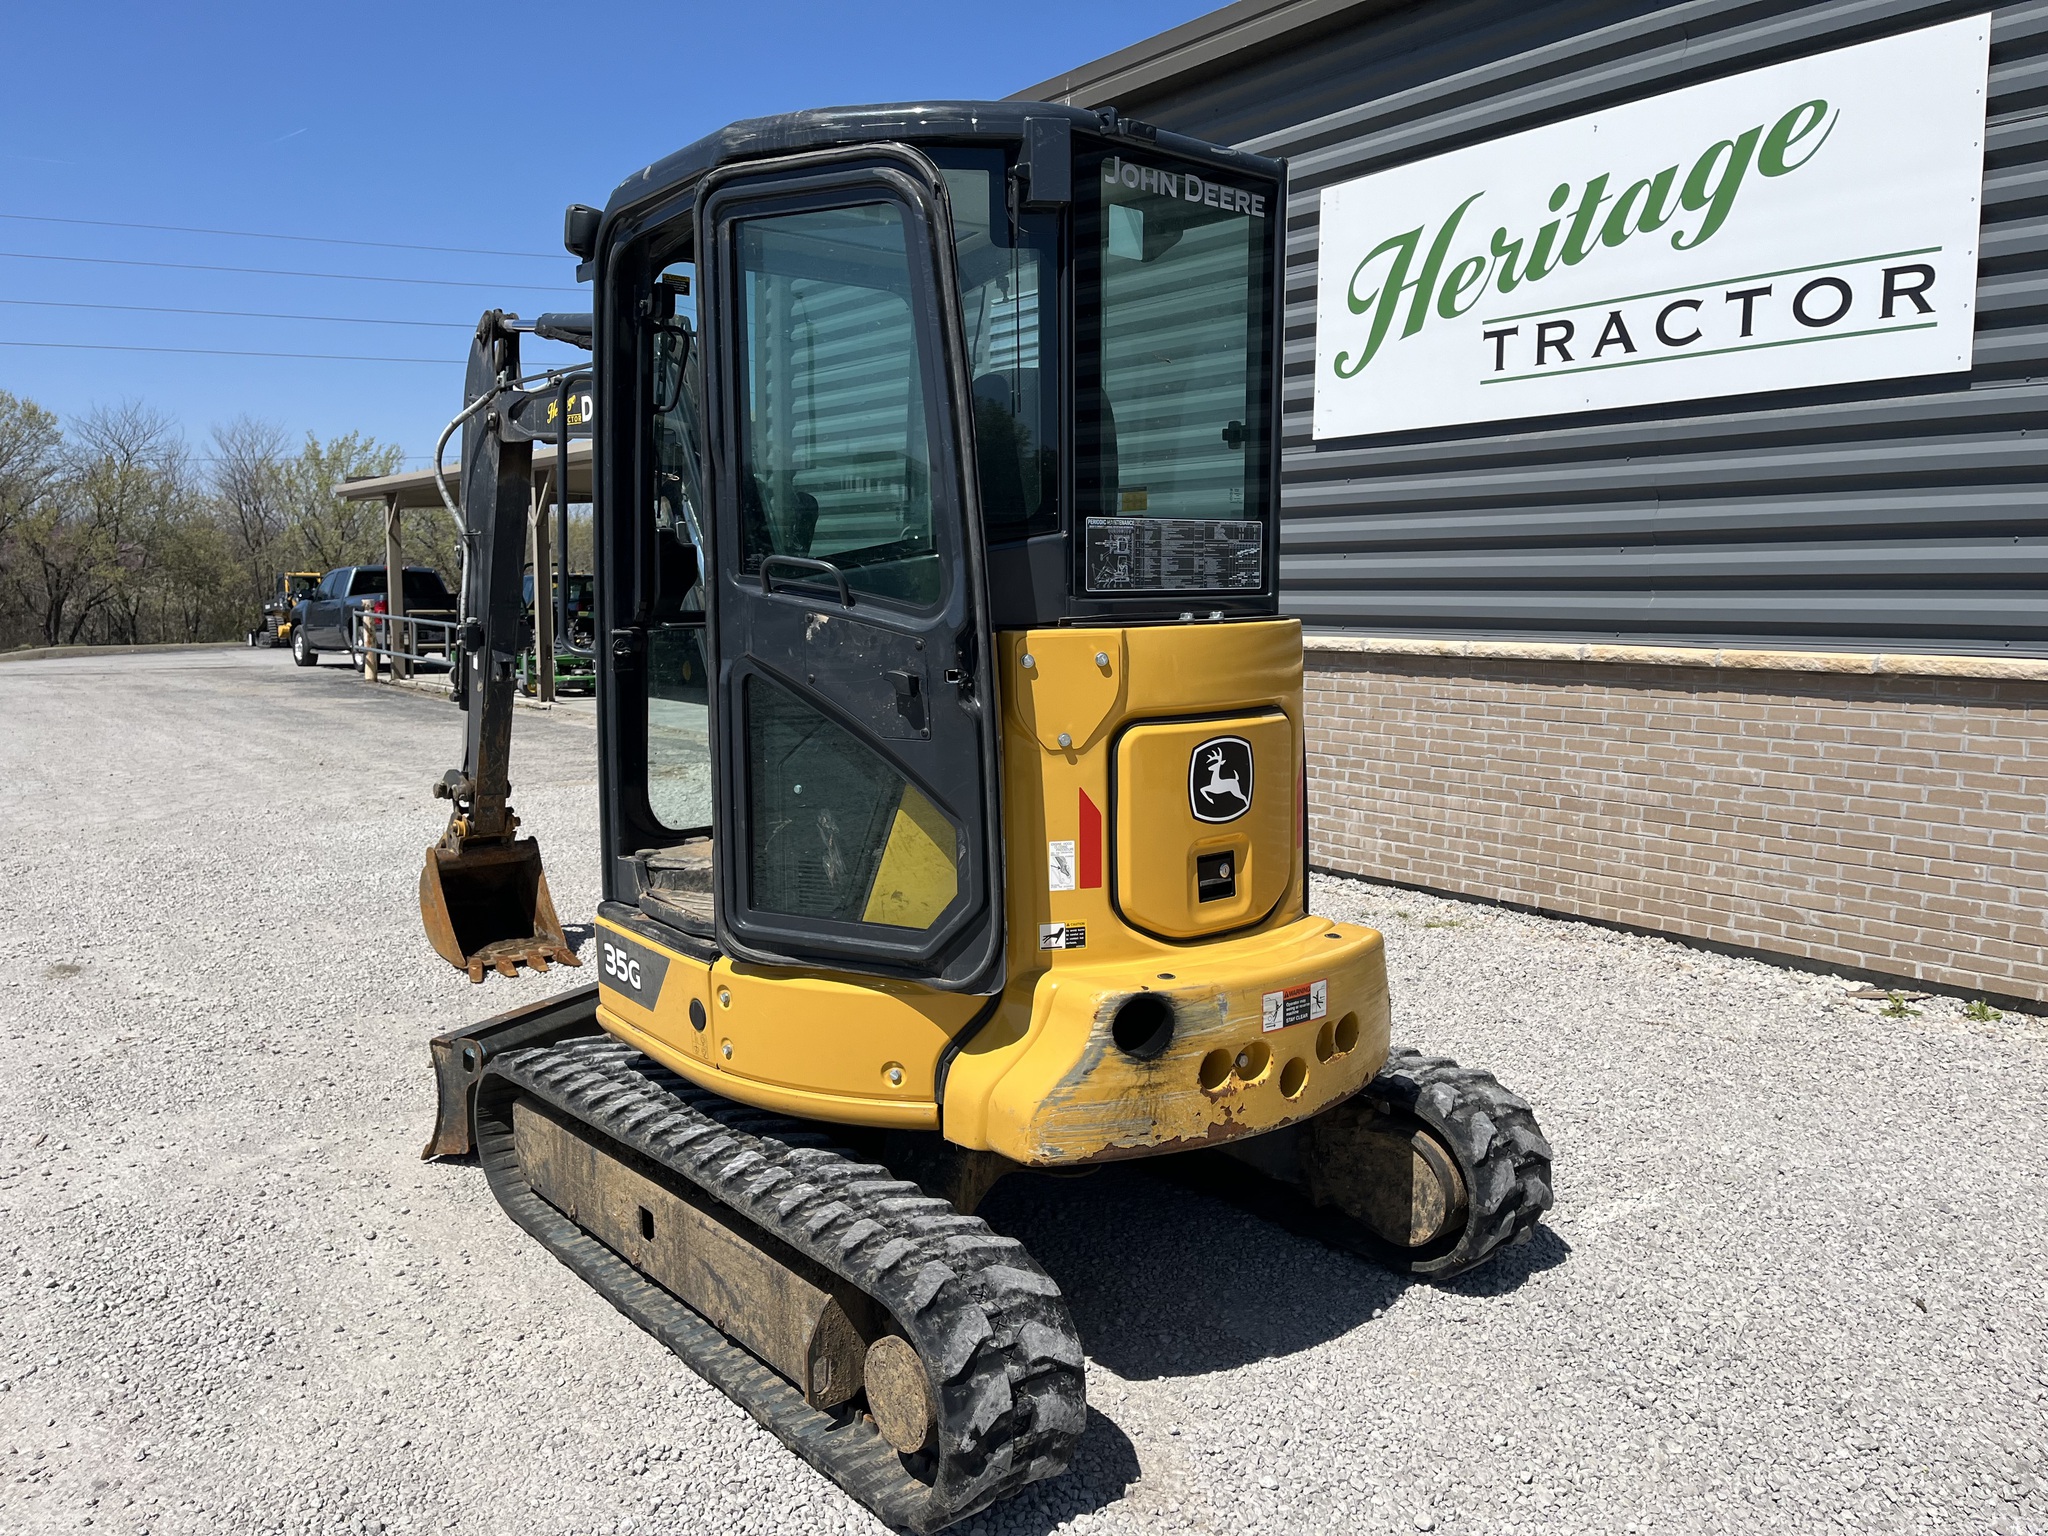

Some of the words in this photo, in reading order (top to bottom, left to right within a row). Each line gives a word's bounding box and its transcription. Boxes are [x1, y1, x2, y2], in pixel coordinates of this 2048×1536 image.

[1104, 156, 1178, 198] JOHN
[1184, 173, 1265, 217] DEERE
[1334, 99, 1839, 378] Heritage
[1483, 263, 1937, 372] TRACTOR
[603, 942, 642, 990] 35G
[1290, 986, 1310, 996] WARNING
